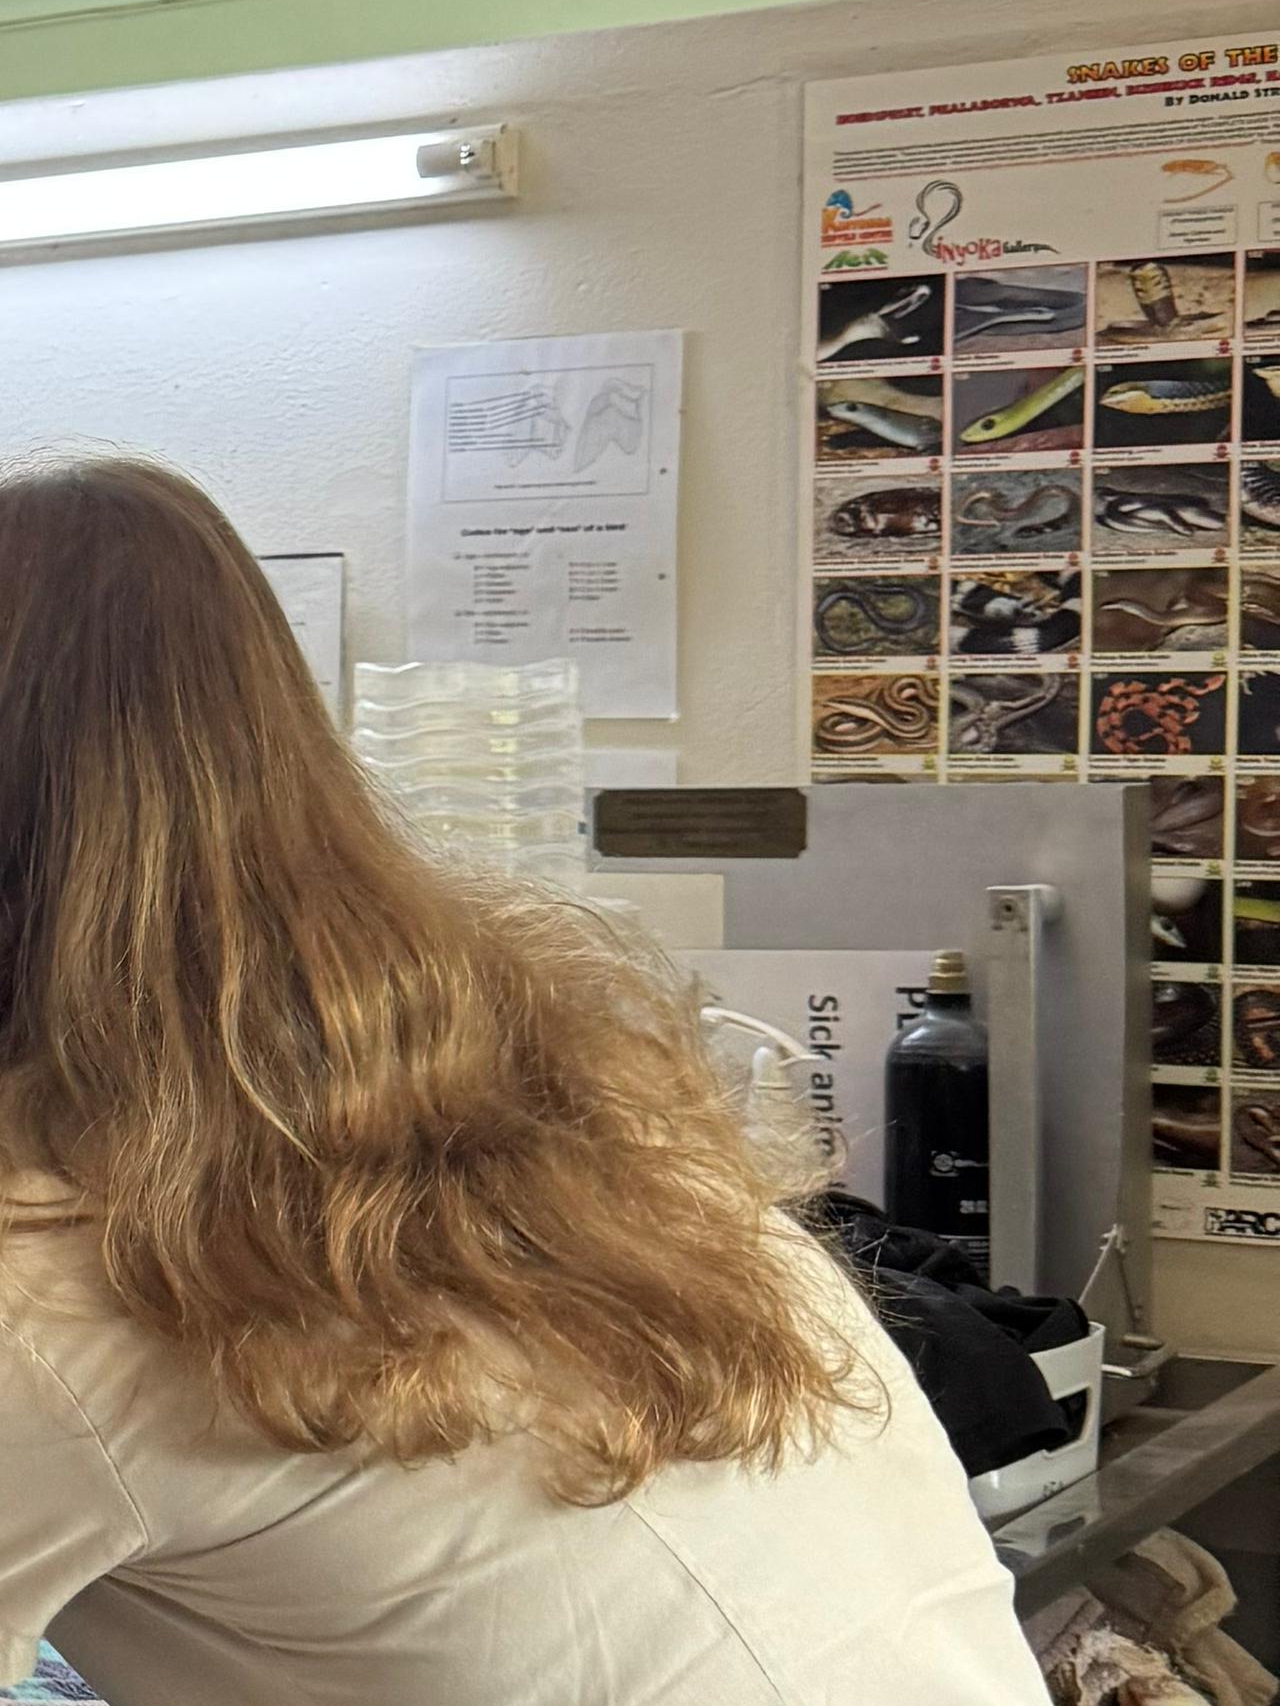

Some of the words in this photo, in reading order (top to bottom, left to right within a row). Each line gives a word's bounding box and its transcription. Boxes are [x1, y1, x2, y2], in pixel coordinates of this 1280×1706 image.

[1067, 56, 1170, 84] SNAKES
[1179, 50, 1216, 72] OF
[1225, 44, 1279, 69] THE
[1189, 90, 1249, 105] DONALD
[808, 994, 841, 1060] Sick
